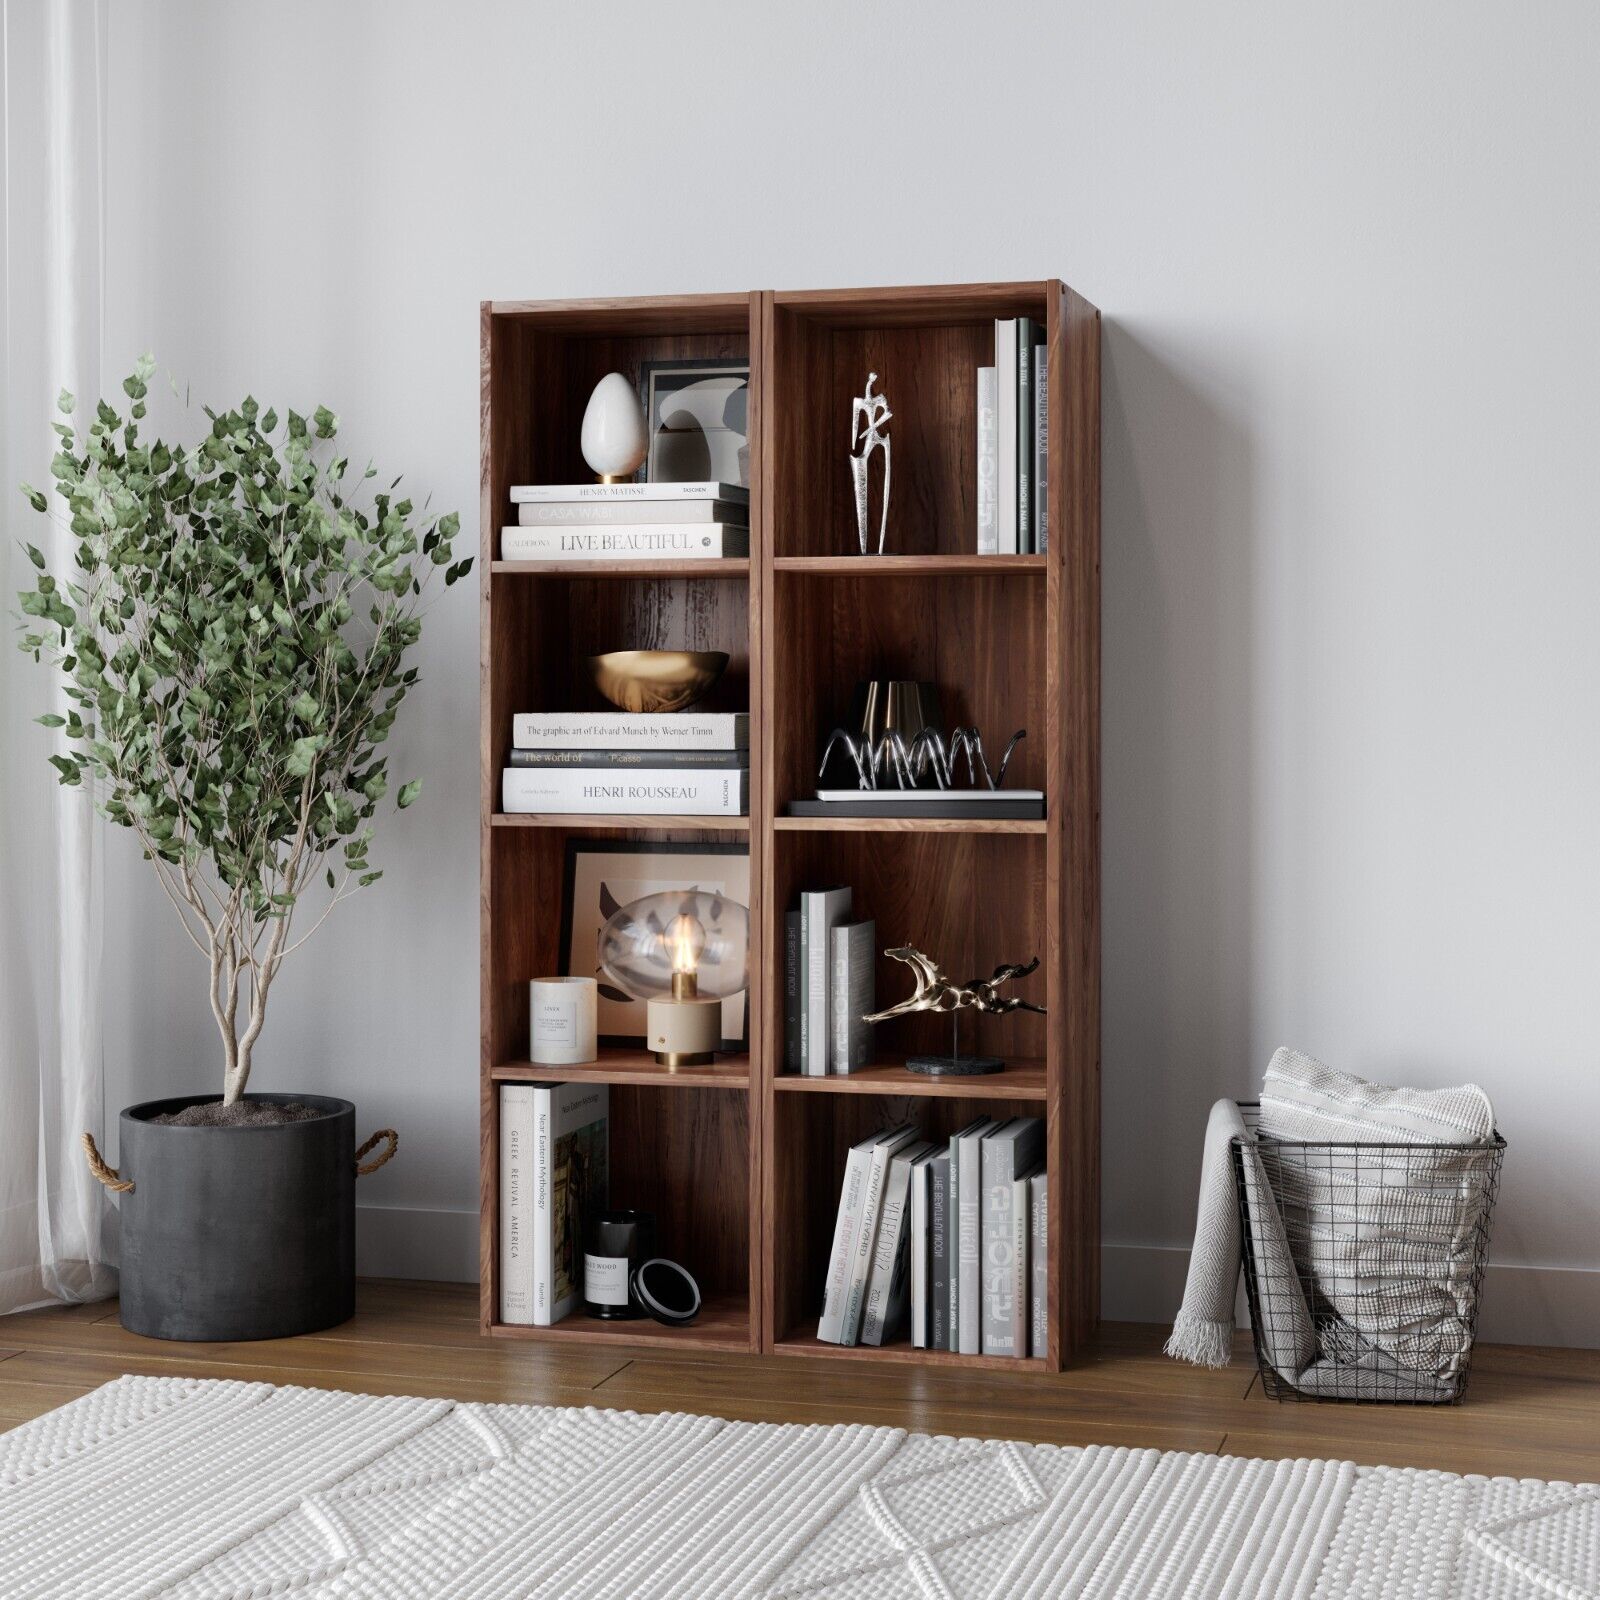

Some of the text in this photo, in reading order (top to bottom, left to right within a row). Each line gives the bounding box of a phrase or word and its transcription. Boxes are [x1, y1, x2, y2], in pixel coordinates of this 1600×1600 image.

[579, 487, 646, 496] HENRY MATISSE
[561, 533, 693, 551] LIVE BEAUTIFUL
[527, 726, 713, 738] The graphic art of Edvard Munch by Werner Timm
[524, 752, 584, 762] The world of
[583, 786, 697, 799] HENRI ROUSSEAU
[538, 1114, 547, 1210] Near Eastern Mythology
[511, 1130, 519, 1259] GREEK REVIVAL AMERICA
